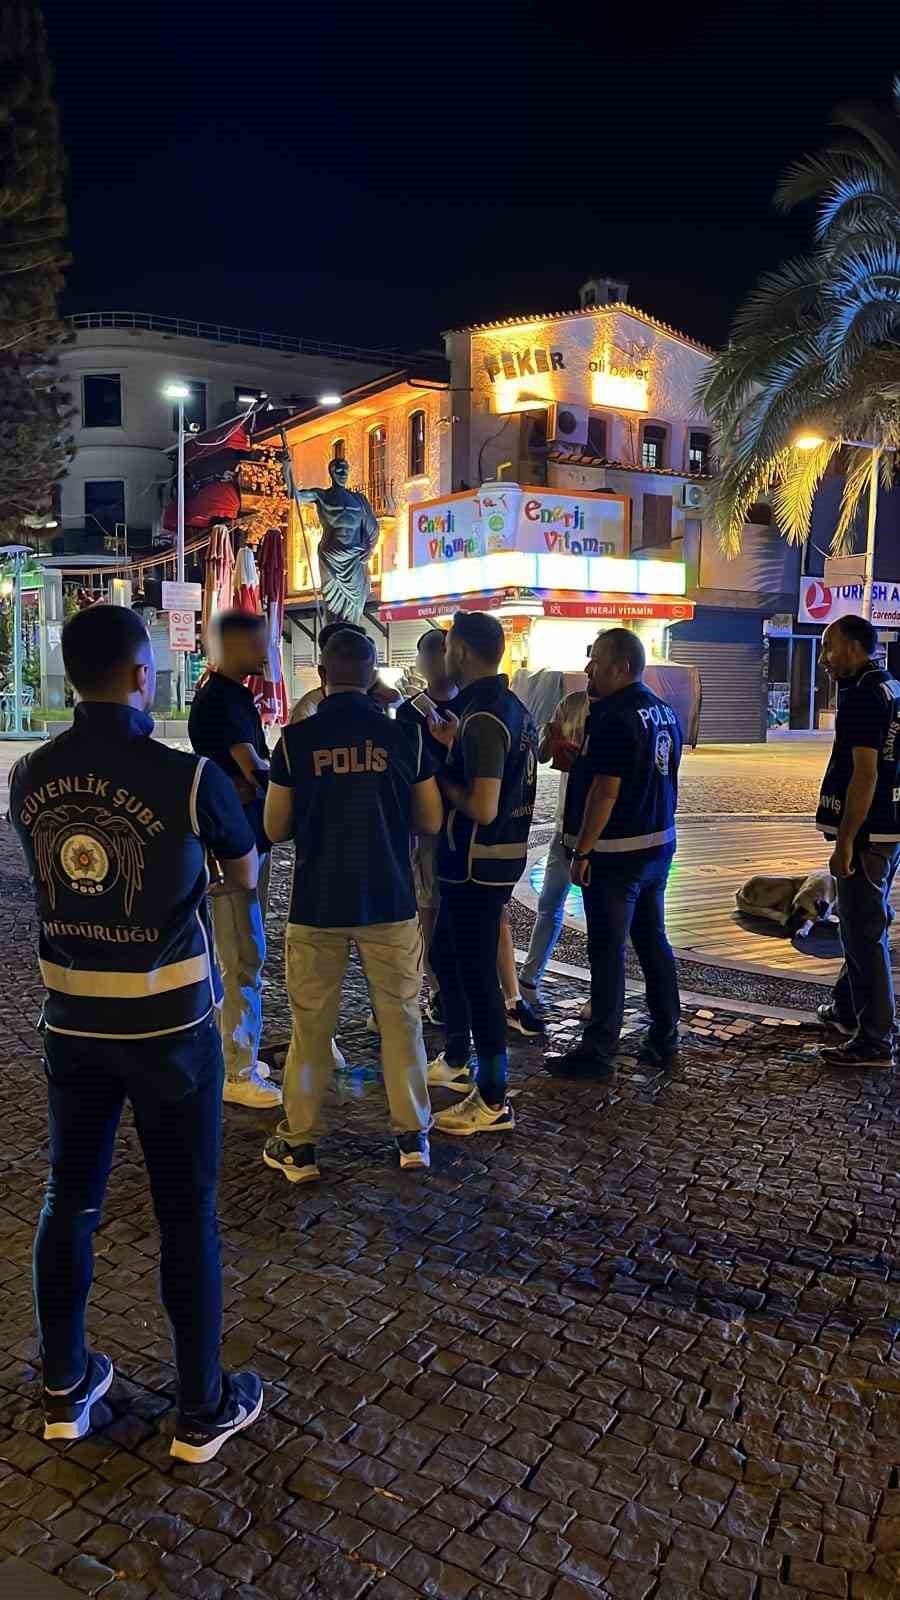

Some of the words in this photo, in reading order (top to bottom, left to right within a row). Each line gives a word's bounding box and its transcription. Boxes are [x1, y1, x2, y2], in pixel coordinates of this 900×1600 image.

[485, 348, 566, 384] PEKER
[637, 704, 676, 728] POLİS
[312, 739, 388, 776] POLİS
[20, 773, 110, 826] GÜVENLİK
[112, 788, 165, 837] ŞUBE
